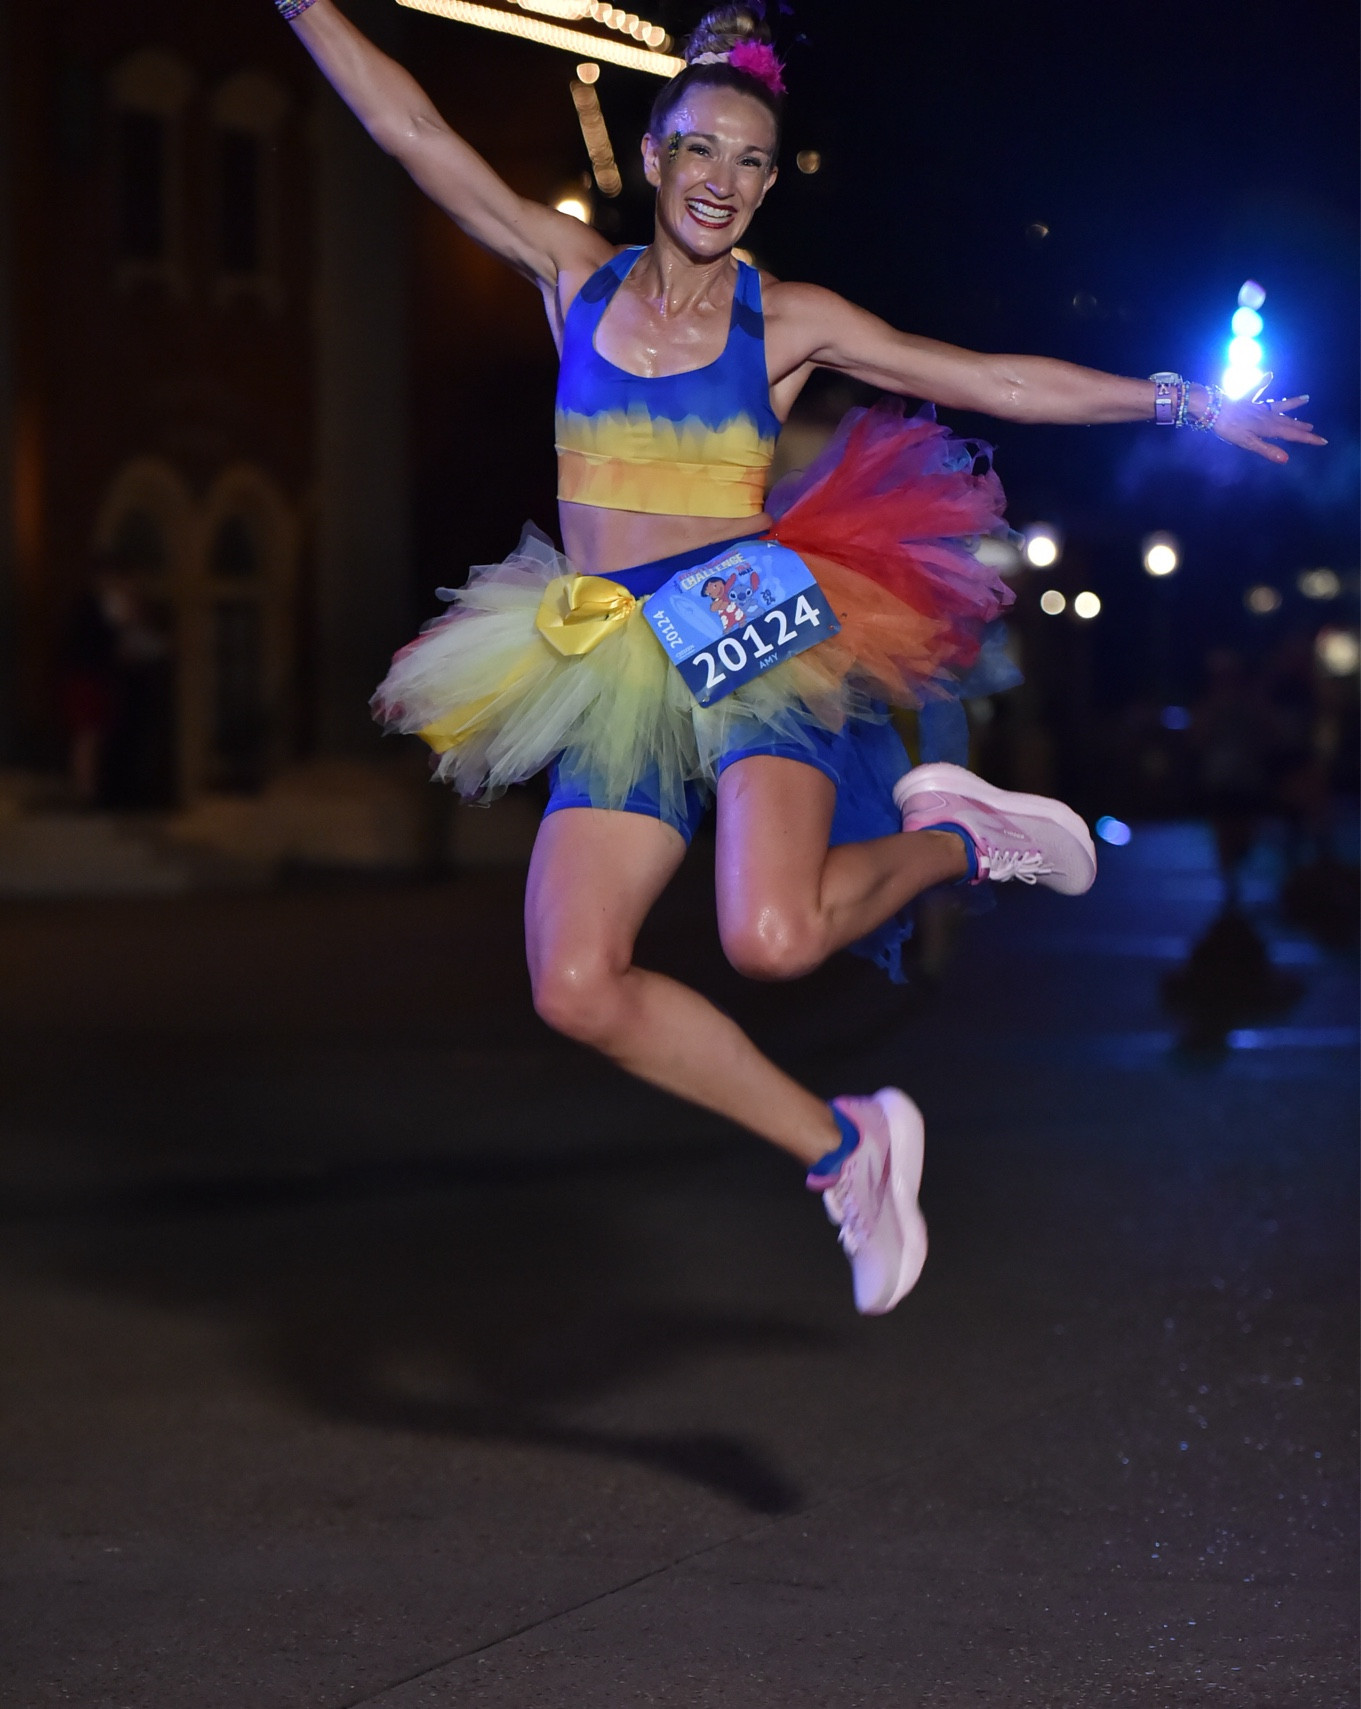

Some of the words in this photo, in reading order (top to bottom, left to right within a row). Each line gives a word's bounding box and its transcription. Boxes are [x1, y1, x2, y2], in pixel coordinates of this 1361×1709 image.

[681, 553, 746, 591] CHALLENGE
[652, 610, 684, 649] 20124
[692, 595, 820, 689] 20124
[759, 653, 779, 670] AMY
